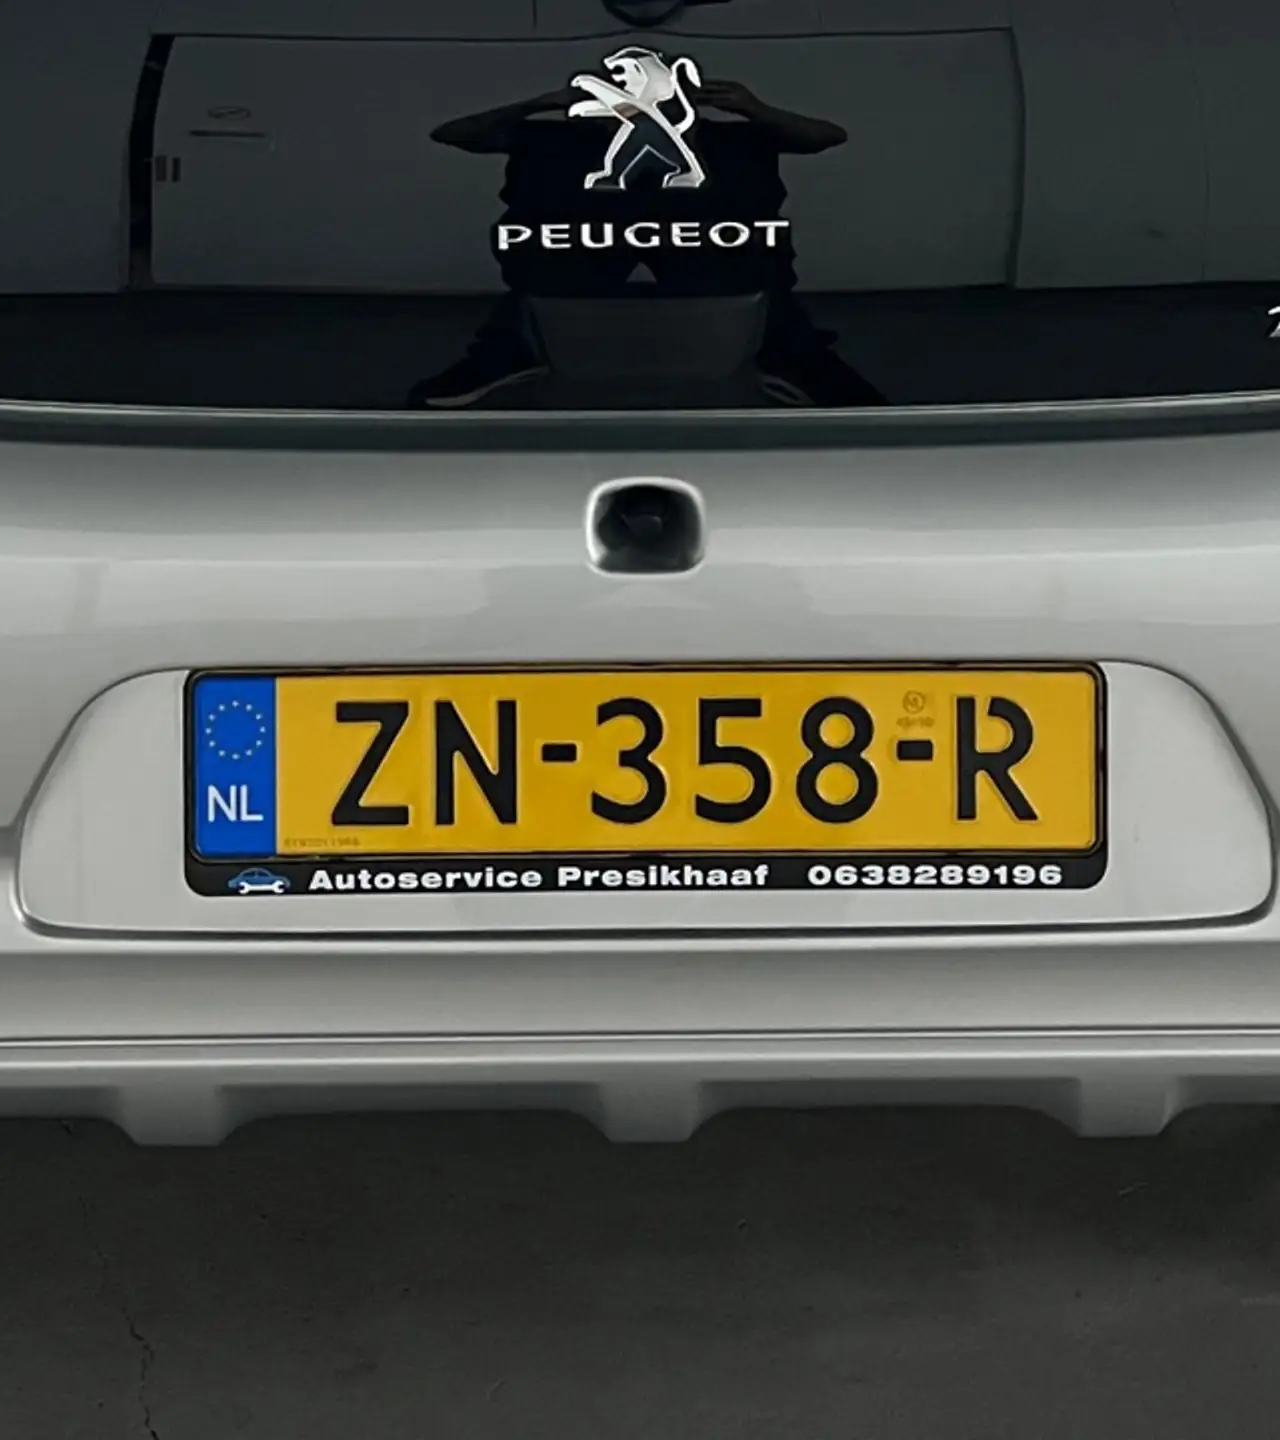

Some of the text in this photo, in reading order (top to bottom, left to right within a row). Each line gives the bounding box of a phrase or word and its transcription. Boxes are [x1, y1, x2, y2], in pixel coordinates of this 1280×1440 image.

[497, 220, 791, 251] PEUGEOT
[207, 695, 1039, 826] NL ZN-358-R
[309, 864, 1063, 891] Autoservice Presikhaaf 0638289196
